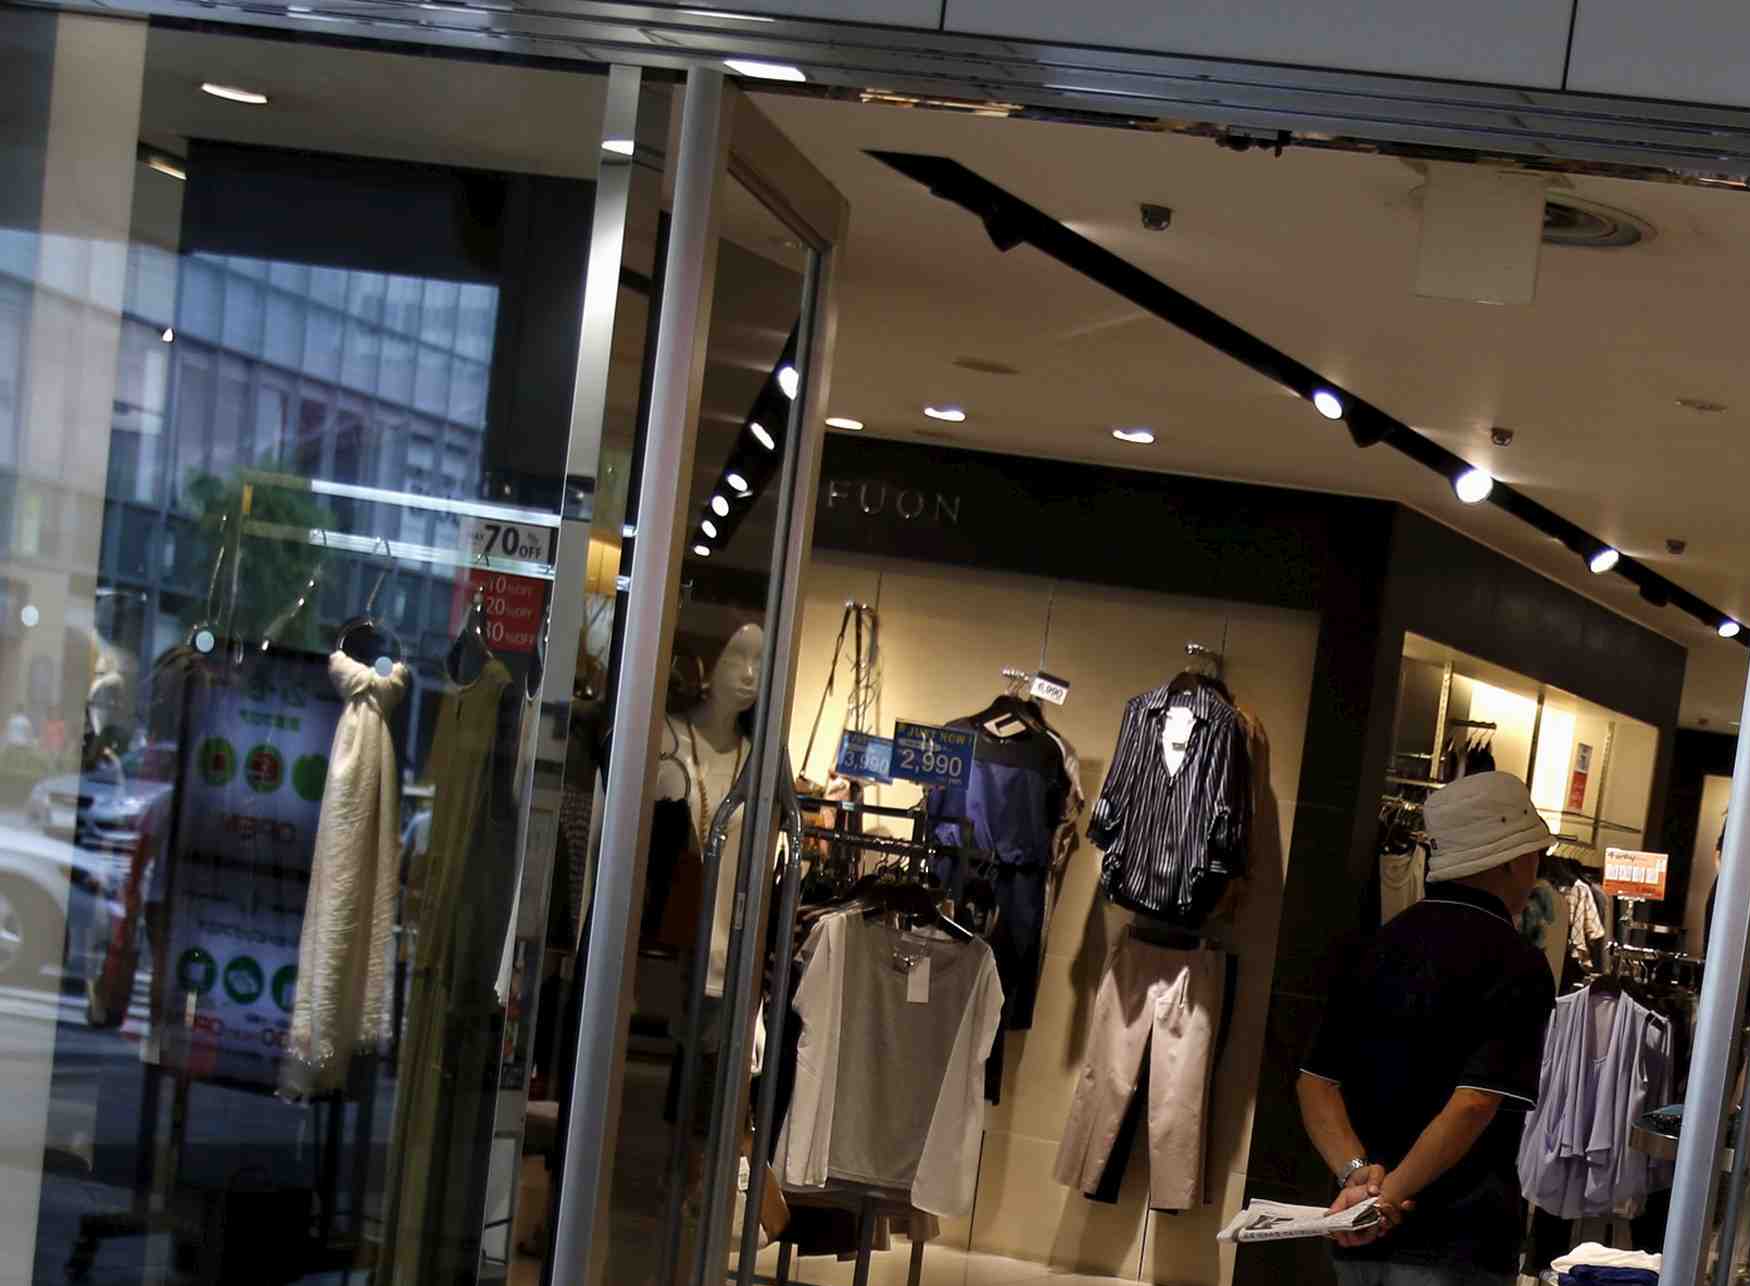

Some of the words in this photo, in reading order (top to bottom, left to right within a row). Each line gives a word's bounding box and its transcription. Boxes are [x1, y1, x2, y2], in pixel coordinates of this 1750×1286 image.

[827, 480, 961, 525] FUON
[484, 524, 519, 555] 70
[900, 749, 962, 777] 2,990
